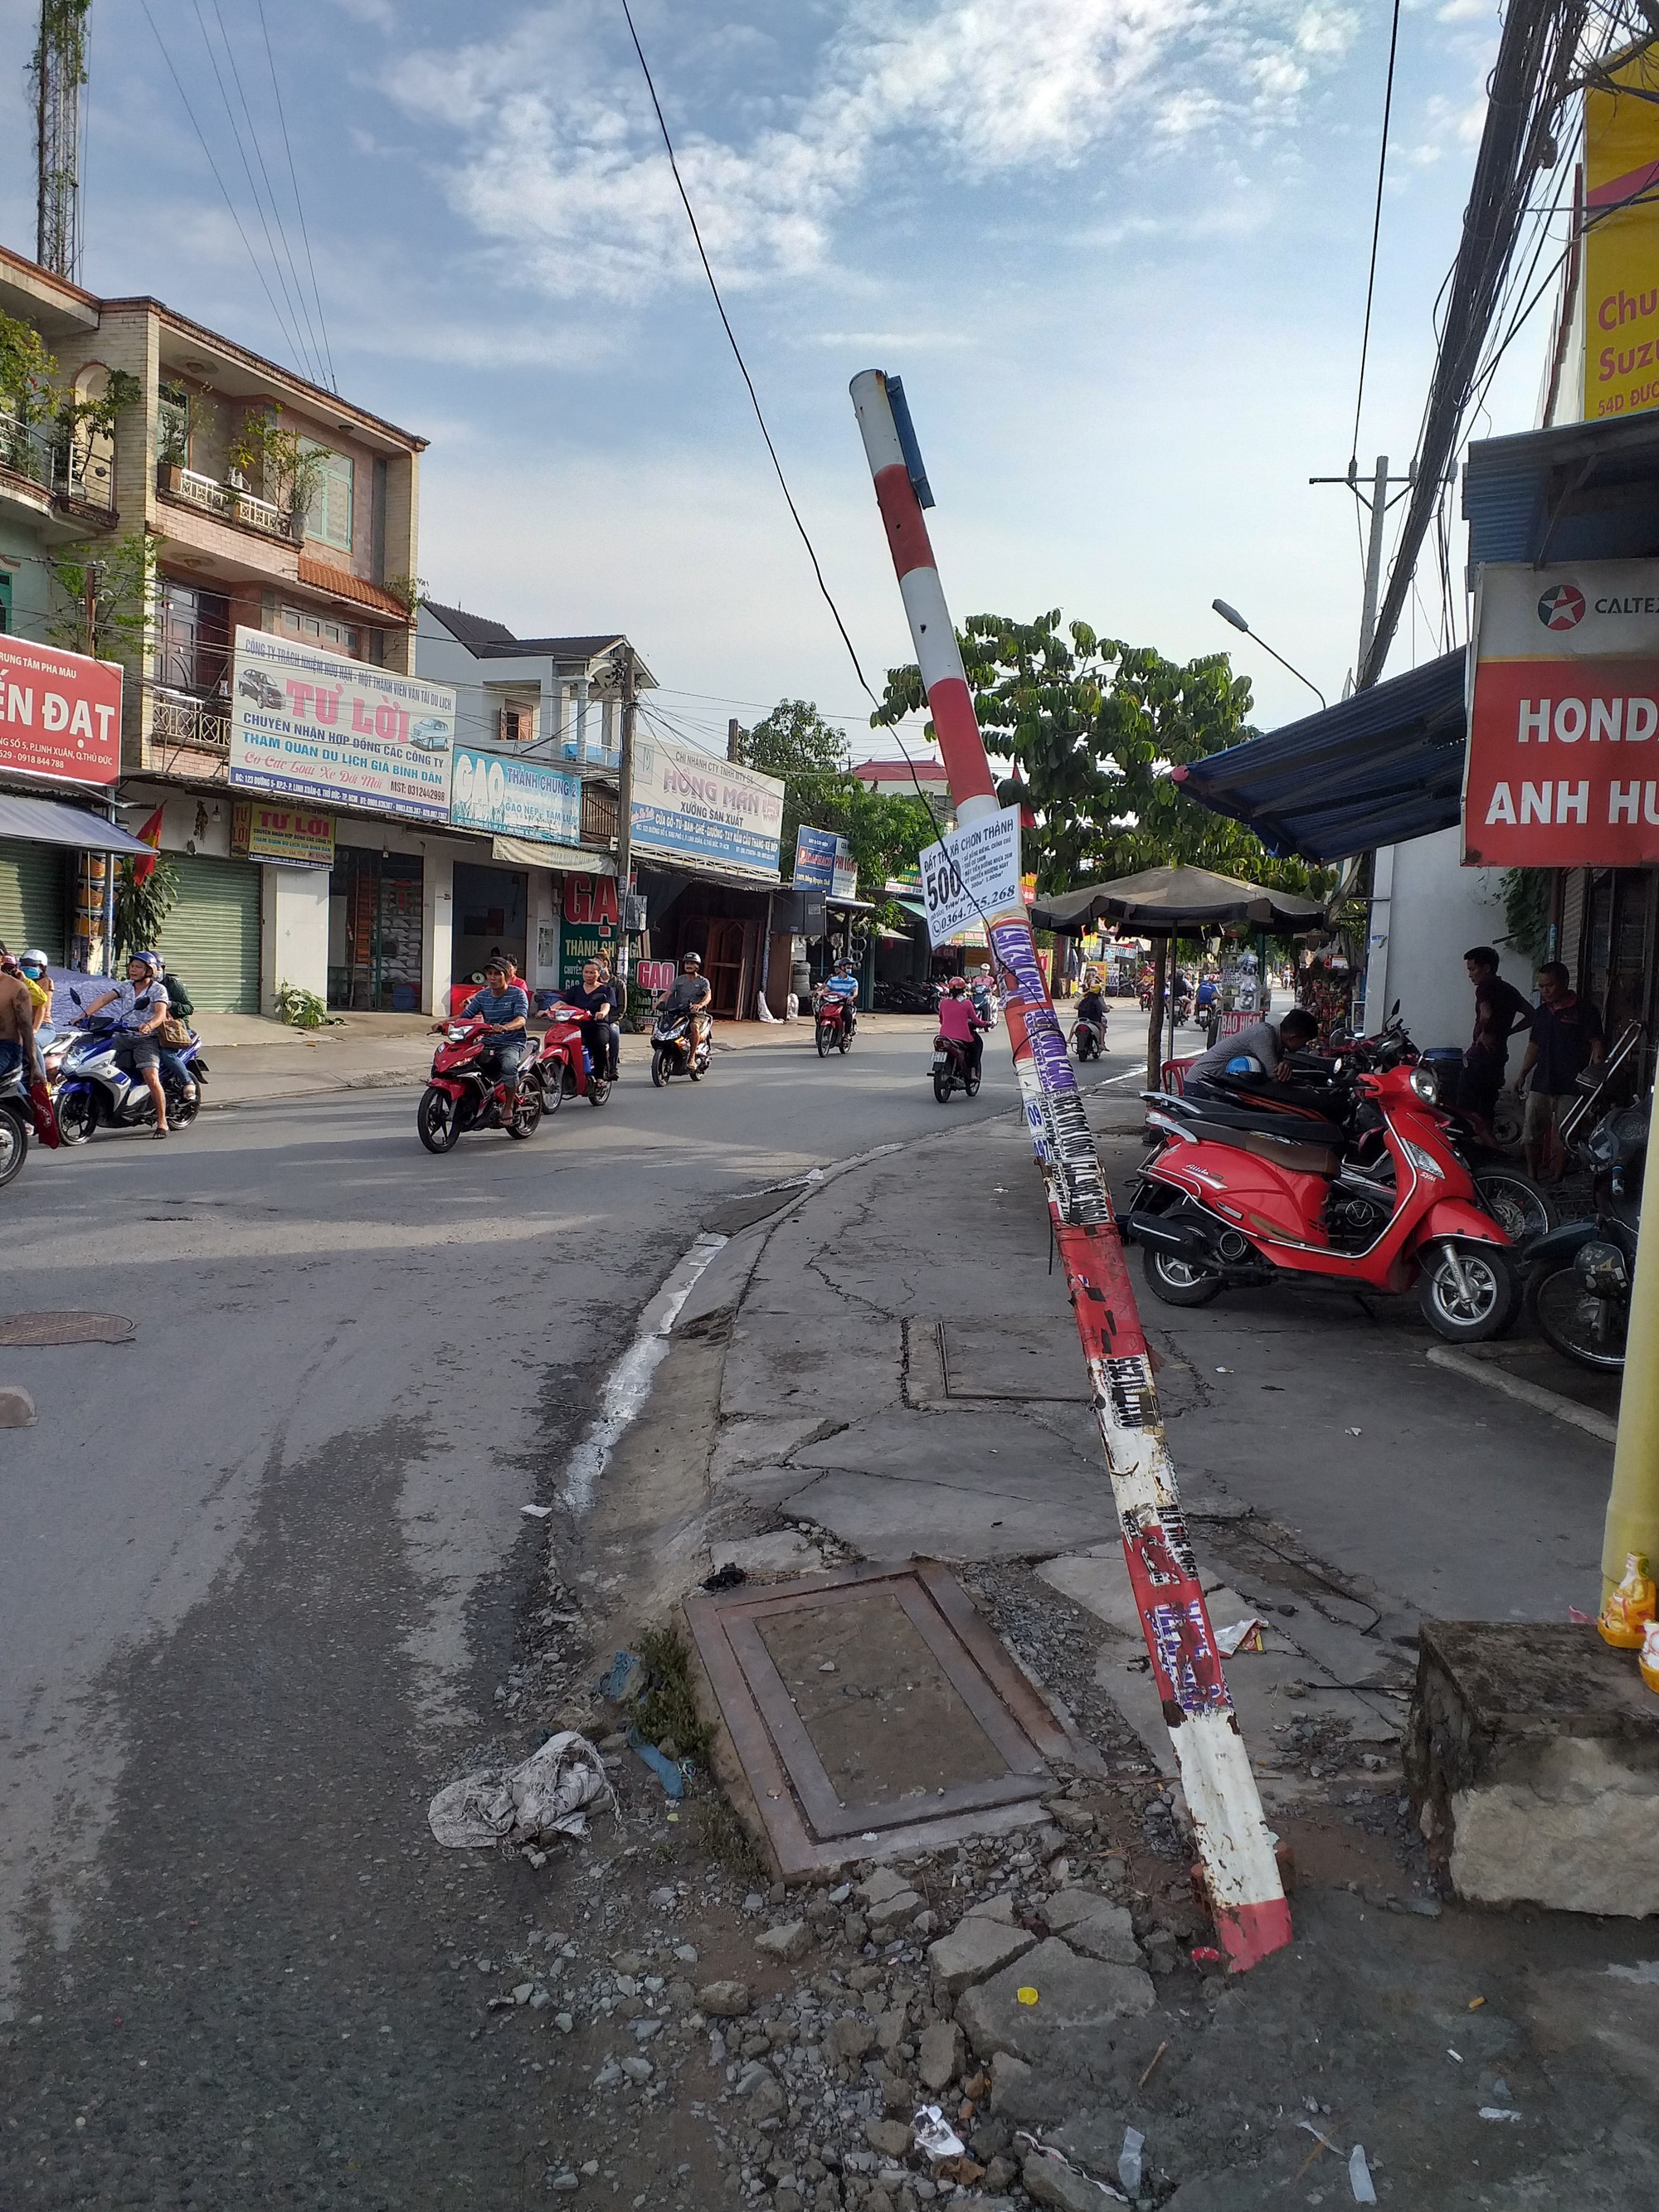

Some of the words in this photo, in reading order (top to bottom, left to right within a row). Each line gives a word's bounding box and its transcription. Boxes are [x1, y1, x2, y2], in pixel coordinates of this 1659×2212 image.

[1598, 340, 1659, 382] Suz
[1598, 393, 1624, 416] 54D
[23, 657, 40, 670] TÂM
[41, 664, 57, 675] PHA
[59, 667, 77, 678] MÀU
[286, 678, 343, 726] TƯ
[352, 694, 411, 744] LỜI
[431, 693, 438, 707] DU
[440, 696, 451, 712] LỊCH
[41, 692, 115, 748] ĐẠT
[1518, 698, 1659, 742] HOND
[10, 737, 20, 748] SỐ
[30, 743, 52, 755] P.LINH
[53, 746, 75, 760] XUÂN,
[98, 754, 113, 766] ĐỨC
[243, 712, 290, 733] CHUYÊN
[294, 724, 325, 741] NHẬN
[328, 732, 349, 746] HỢP
[353, 737, 381, 754] ĐỒNG
[383, 743, 403, 759] CÁC
[406, 750, 431, 766] CÔNG
[434, 757, 444, 768] TY
[17, 753, 36, 764] 0918
[36, 756, 50, 766] 844
[51, 759, 64, 769] 788
[242, 732, 280, 749] THAM
[285, 741, 318, 757] QUAN
[322, 749, 338, 761] DU
[342, 753, 367, 767] LỊCH
[371, 760, 389, 773] GIÁ
[392, 765, 418, 779] BÌNH
[421, 771, 442, 785] DÂN
[319, 766, 336, 780] Xe
[675, 751, 686, 763] CHI
[687, 755, 707, 770] NHÁNH
[708, 761, 719, 773] CTY
[720, 766, 734, 778] TNHH
[390, 780, 406, 794] MST:
[407, 785, 445, 802] 0312442998
[507, 766, 538, 789] THÀNH
[540, 775, 569, 796] CHUNG
[571, 782, 577, 798] 2
[664, 767, 718, 805] HỒNG
[680, 801, 708, 819] XƯỞNG
[1485, 781, 1589, 824] ANH
[259, 810, 290, 829] TƯ
[294, 816, 329, 838] LỜI
[924, 854, 937, 873] ĐẤT
[961, 831, 981, 852] CHƠN
[984, 819, 1014, 841] THÀNH
[927, 859, 961, 912] 500
[565, 936, 596, 956] THÀNH
[637, 960, 674, 997] GẠO
[1420, 1171, 1437, 1183] SYM
